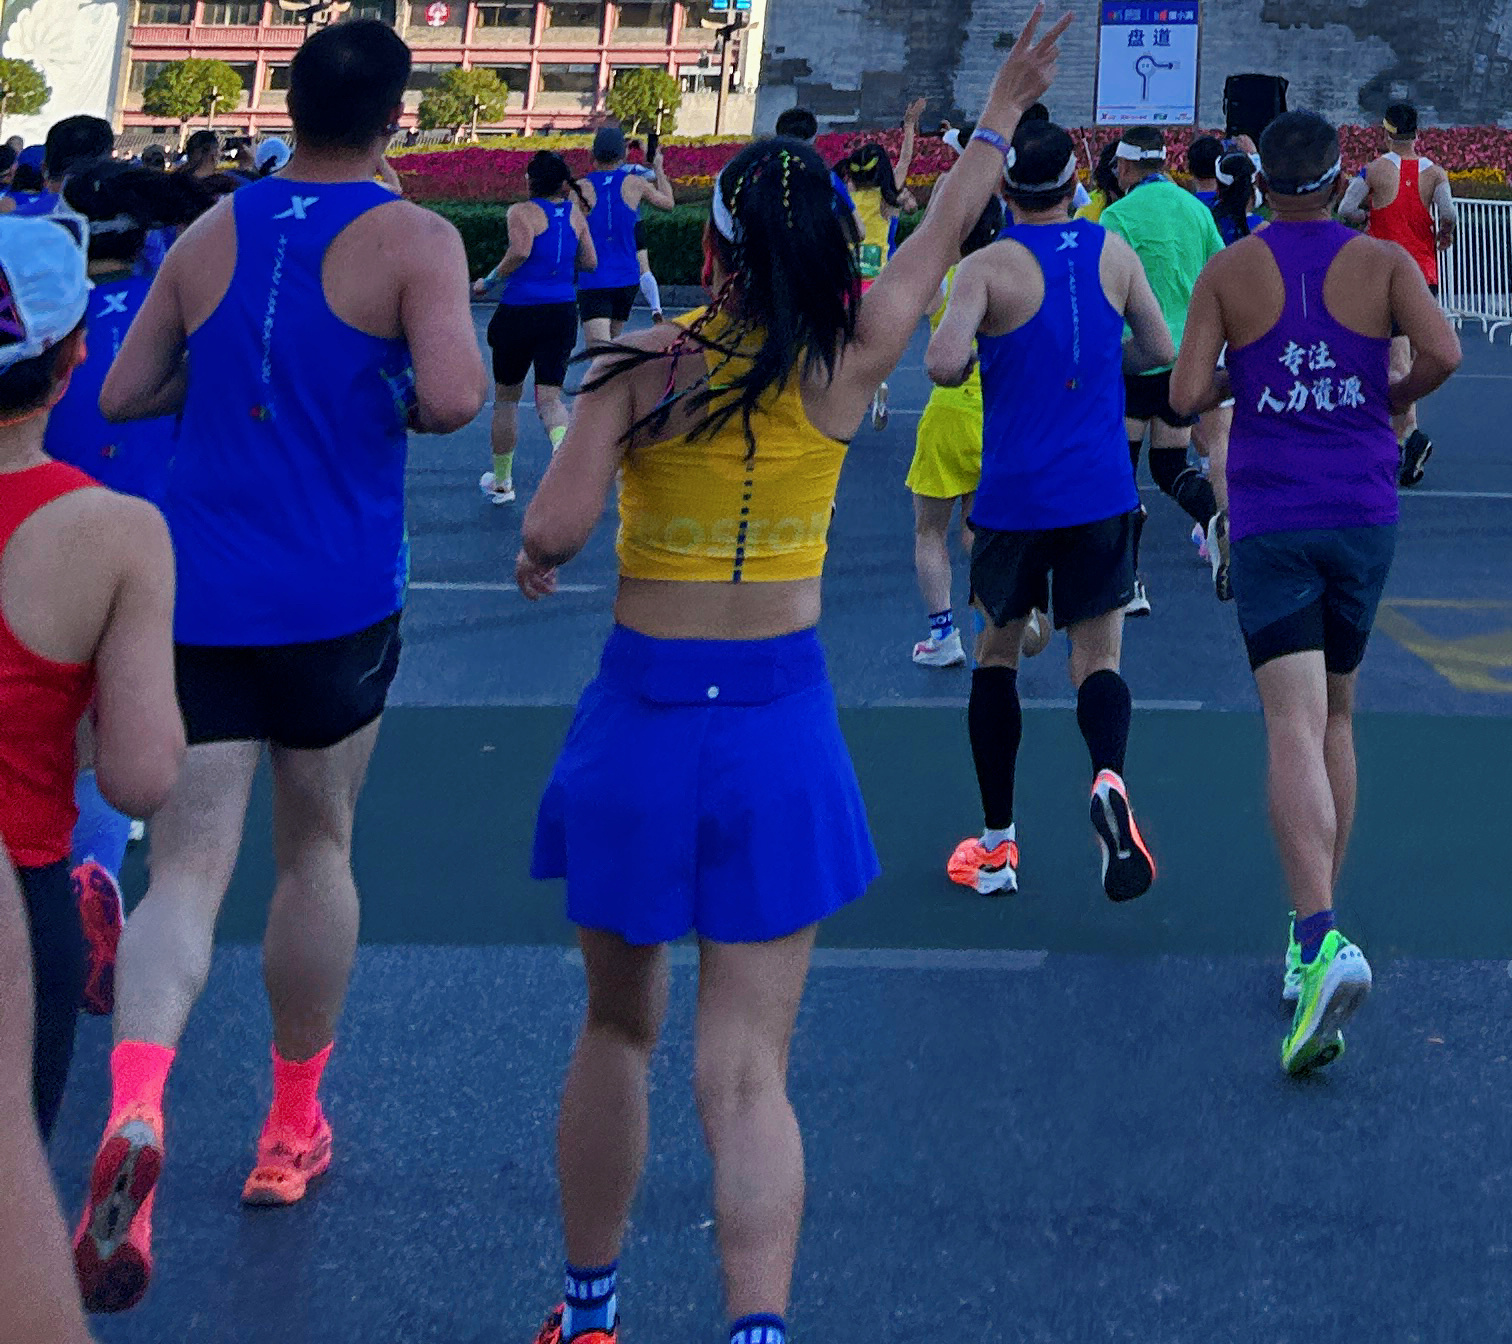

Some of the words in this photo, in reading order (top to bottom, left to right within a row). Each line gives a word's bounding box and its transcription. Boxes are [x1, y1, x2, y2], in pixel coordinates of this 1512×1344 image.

[1127, 27, 1171, 47] 盘道
[1279, 340, 1336, 376] 专注
[1257, 375, 1366, 412] 人力资源
